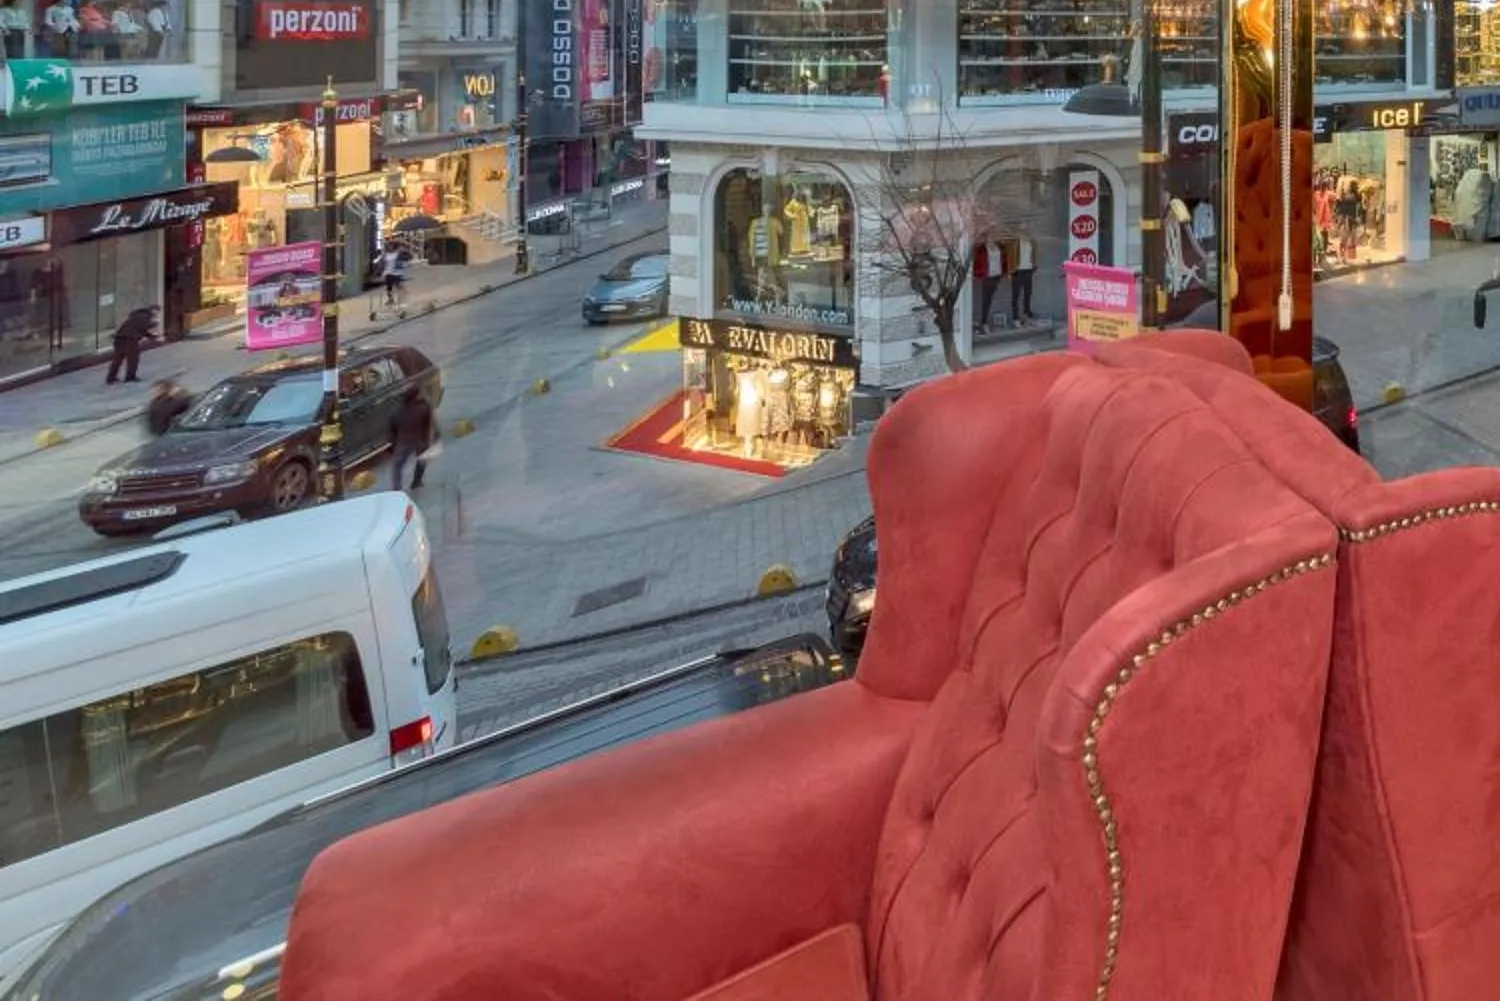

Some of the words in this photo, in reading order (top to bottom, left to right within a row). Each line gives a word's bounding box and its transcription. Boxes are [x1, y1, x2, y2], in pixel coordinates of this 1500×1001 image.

[271, 6, 357, 38] perzoni
[554, 20, 571, 99] DOSSO
[80, 74, 139, 96] TEB
[315, 102, 370, 126] przoni
[1073, 188, 1095, 198] SALE
